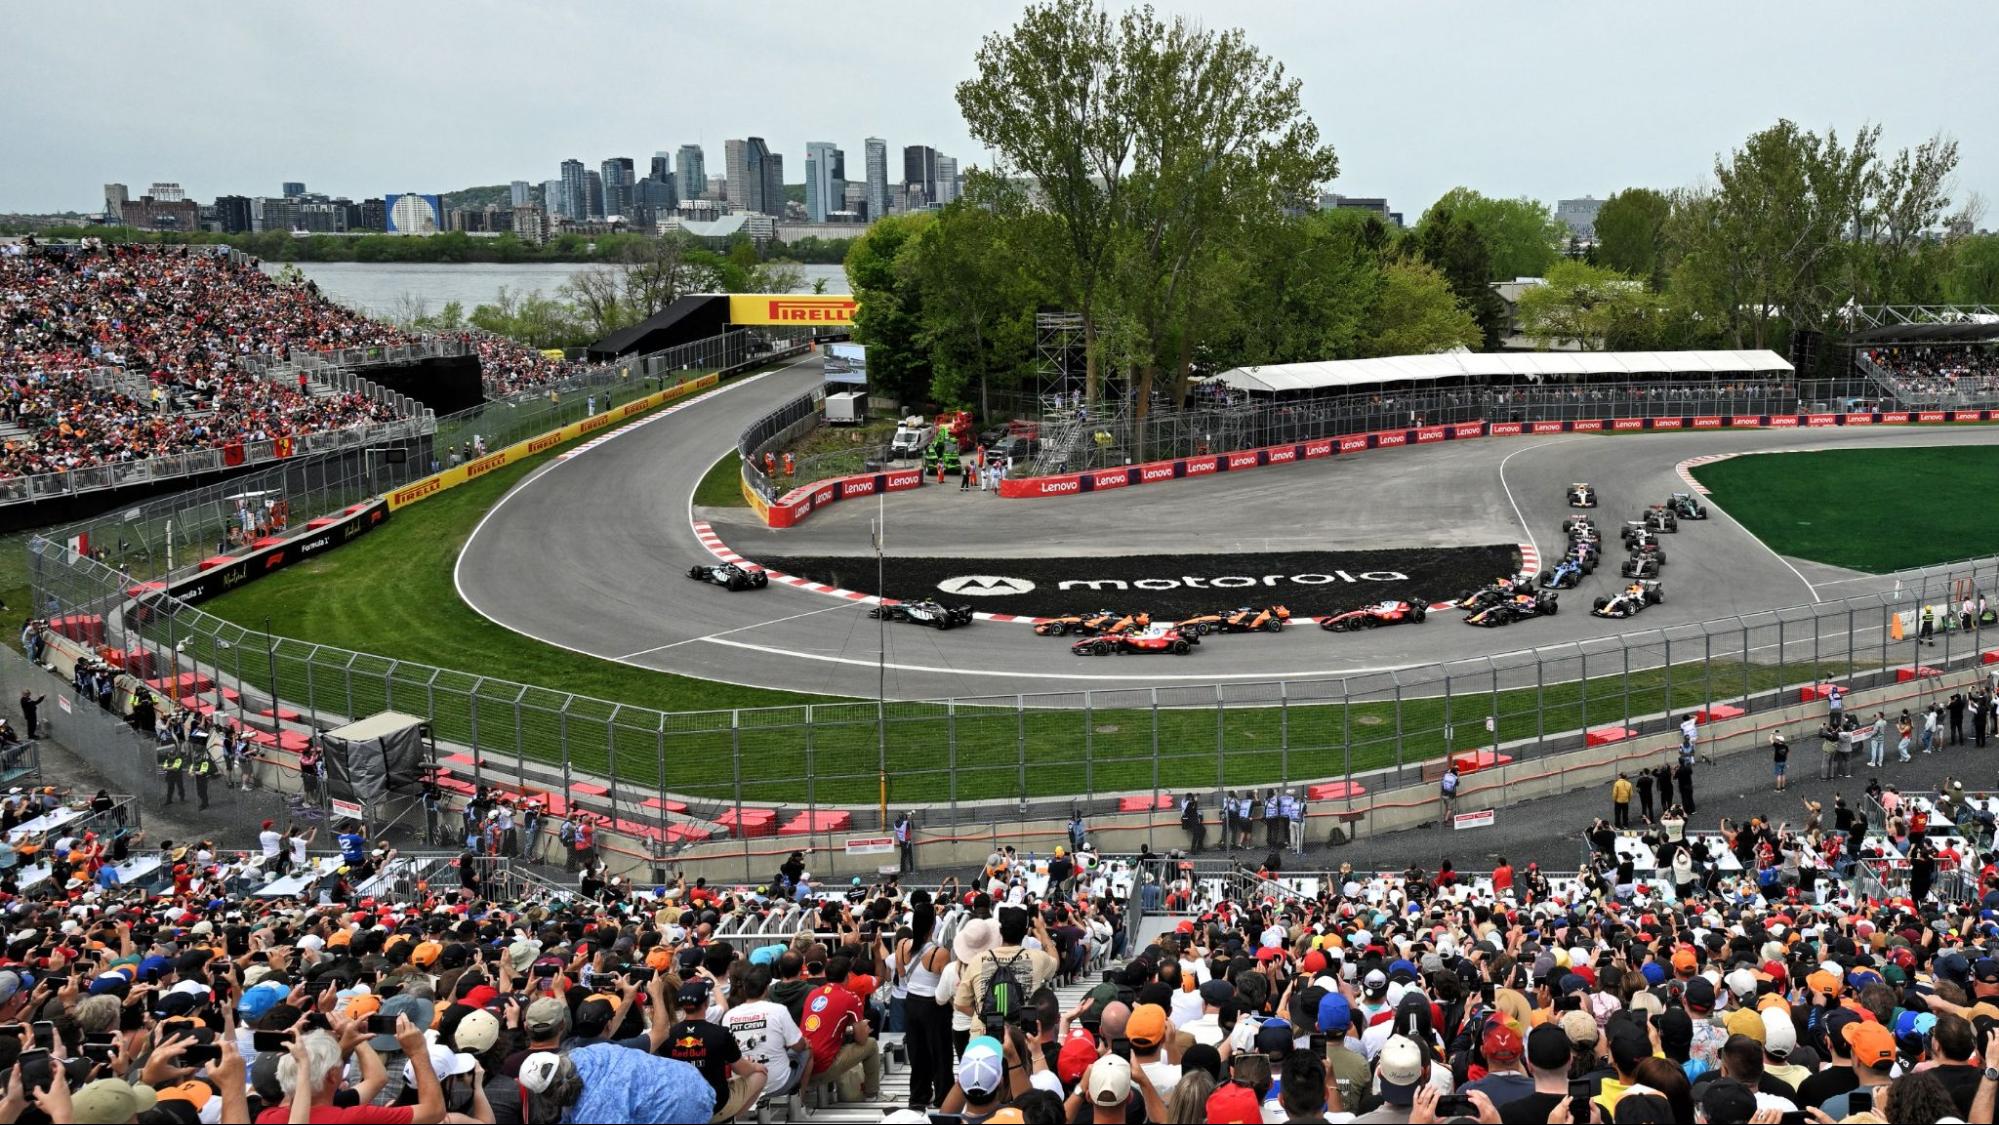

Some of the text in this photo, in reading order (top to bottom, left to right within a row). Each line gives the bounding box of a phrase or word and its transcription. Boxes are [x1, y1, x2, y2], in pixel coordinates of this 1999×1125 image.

[624, 399, 649, 416] PIRELLI
[1695, 417, 1719, 425] Lenovo
[1772, 417, 1795, 425] Lenovo
[1810, 416, 1833, 424] Lenovo
[1847, 415, 1870, 423] Lenovo
[1920, 413, 1943, 421] Lenovo
[1956, 412, 1978, 420] Lenovo
[580, 415, 608, 433] PIRELLI
[1535, 422, 1560, 431] Lenovo
[1575, 421, 1600, 429] Lenovo
[1616, 420, 1640, 428] Lenovo
[1656, 418, 1680, 426] Lenovo
[1457, 426, 1480, 436] Lenovo
[1494, 424, 1519, 433] Lenovo
[1380, 434, 1404, 444] Lenovo
[1419, 429, 1443, 440] Lenovo
[528, 432, 560, 453] PIRELLI
[1341, 440, 1365, 450] Lenovo
[1307, 445, 1330, 455] Lenovo
[1231, 455, 1255, 466] Lenovo
[1270, 451, 1294, 461] Lenovo
[467, 453, 505, 477] PIRELLI
[1188, 461, 1215, 473] Lenovo
[1144, 467, 1172, 479] Lenovo
[889, 475, 919, 487] Lenovo
[1096, 474, 1126, 486] Lenovo
[394, 478, 440, 505] PIRELLI
[845, 481, 873, 495] Lenovo
[1042, 480, 1077, 493] Lenovo
[816, 490, 831, 504] Lenovo
[795, 502, 810, 518] Lenovo
[301, 539, 325, 552] Formula
[1059, 570, 1410, 591] motorola
[730, 1014, 760, 1023] Formula
[731, 1021, 765, 1031] PIT CREW
[672, 1048, 706, 1057] Red Bull
